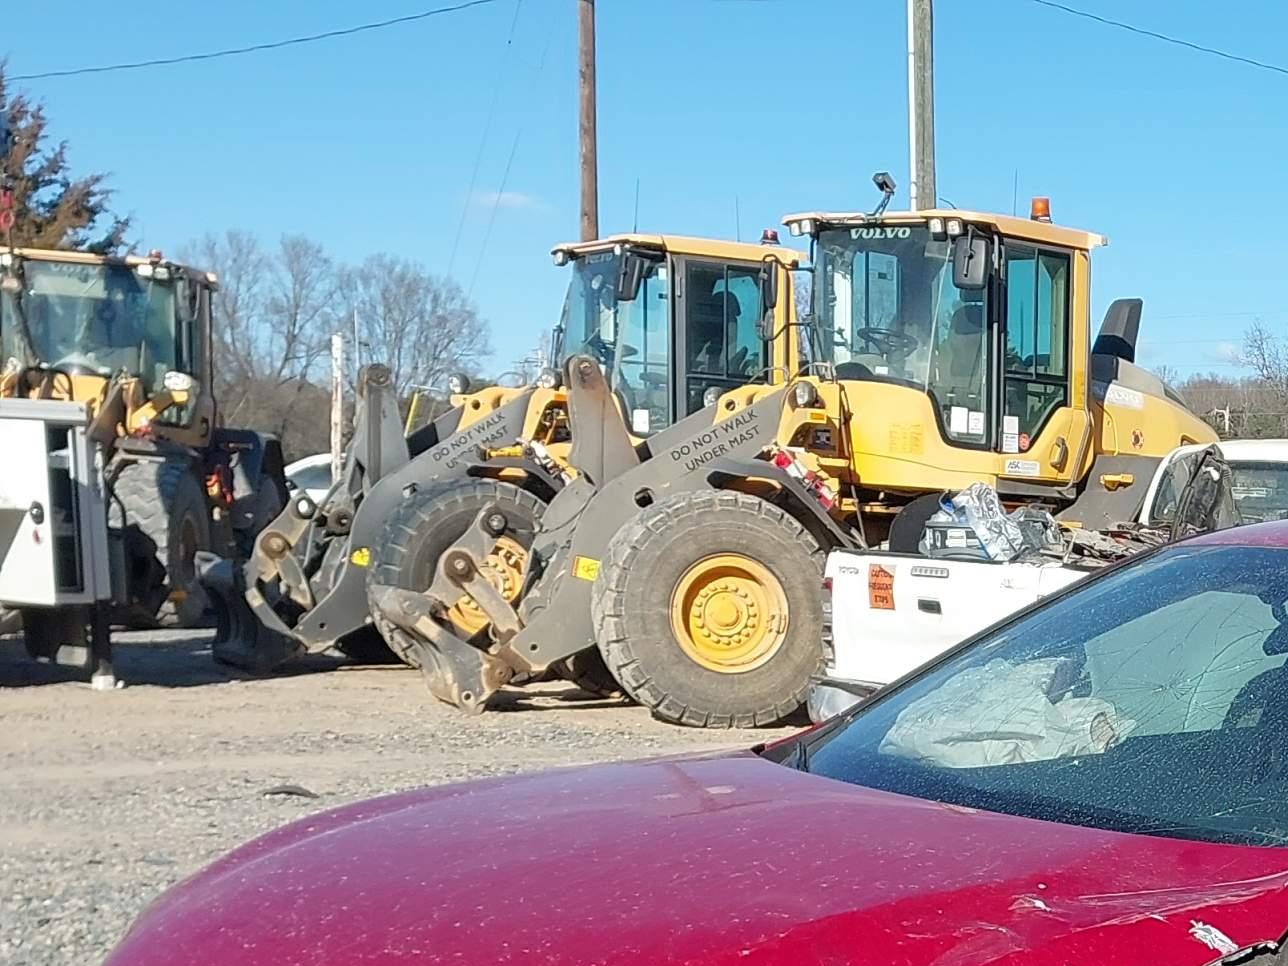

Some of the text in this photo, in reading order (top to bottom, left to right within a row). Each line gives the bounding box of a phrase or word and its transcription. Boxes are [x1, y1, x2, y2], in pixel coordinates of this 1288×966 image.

[850, 227, 911, 239] VOLVO
[433, 411, 506, 462] DO NOT WALK
[670, 410, 758, 461] DO NOT WALK
[685, 425, 760, 472] UNDER MAST
